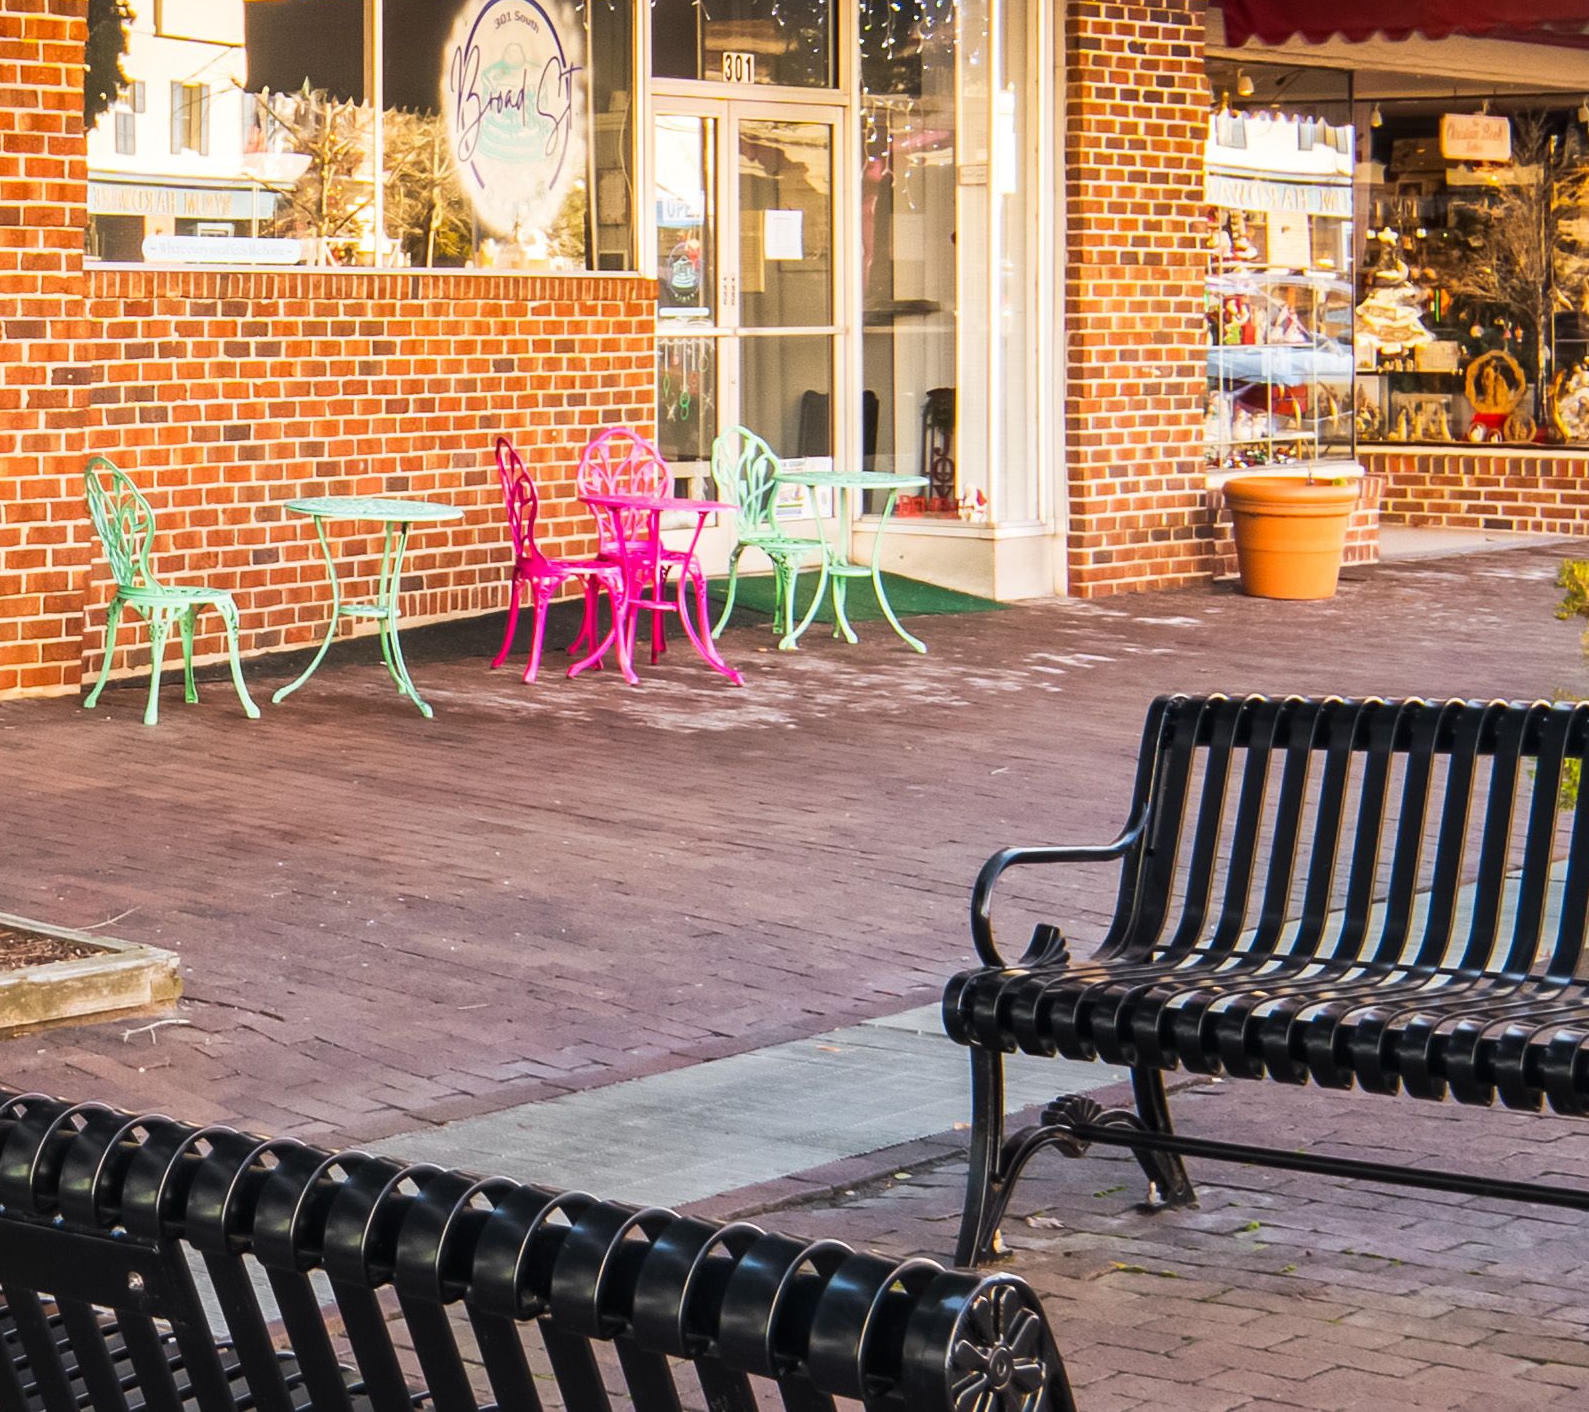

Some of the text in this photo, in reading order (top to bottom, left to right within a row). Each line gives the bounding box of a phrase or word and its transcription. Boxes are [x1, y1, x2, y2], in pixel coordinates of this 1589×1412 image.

[513, 10, 541, 34] South
[724, 53, 753, 83] 301
[450, 44, 528, 163] Broad
